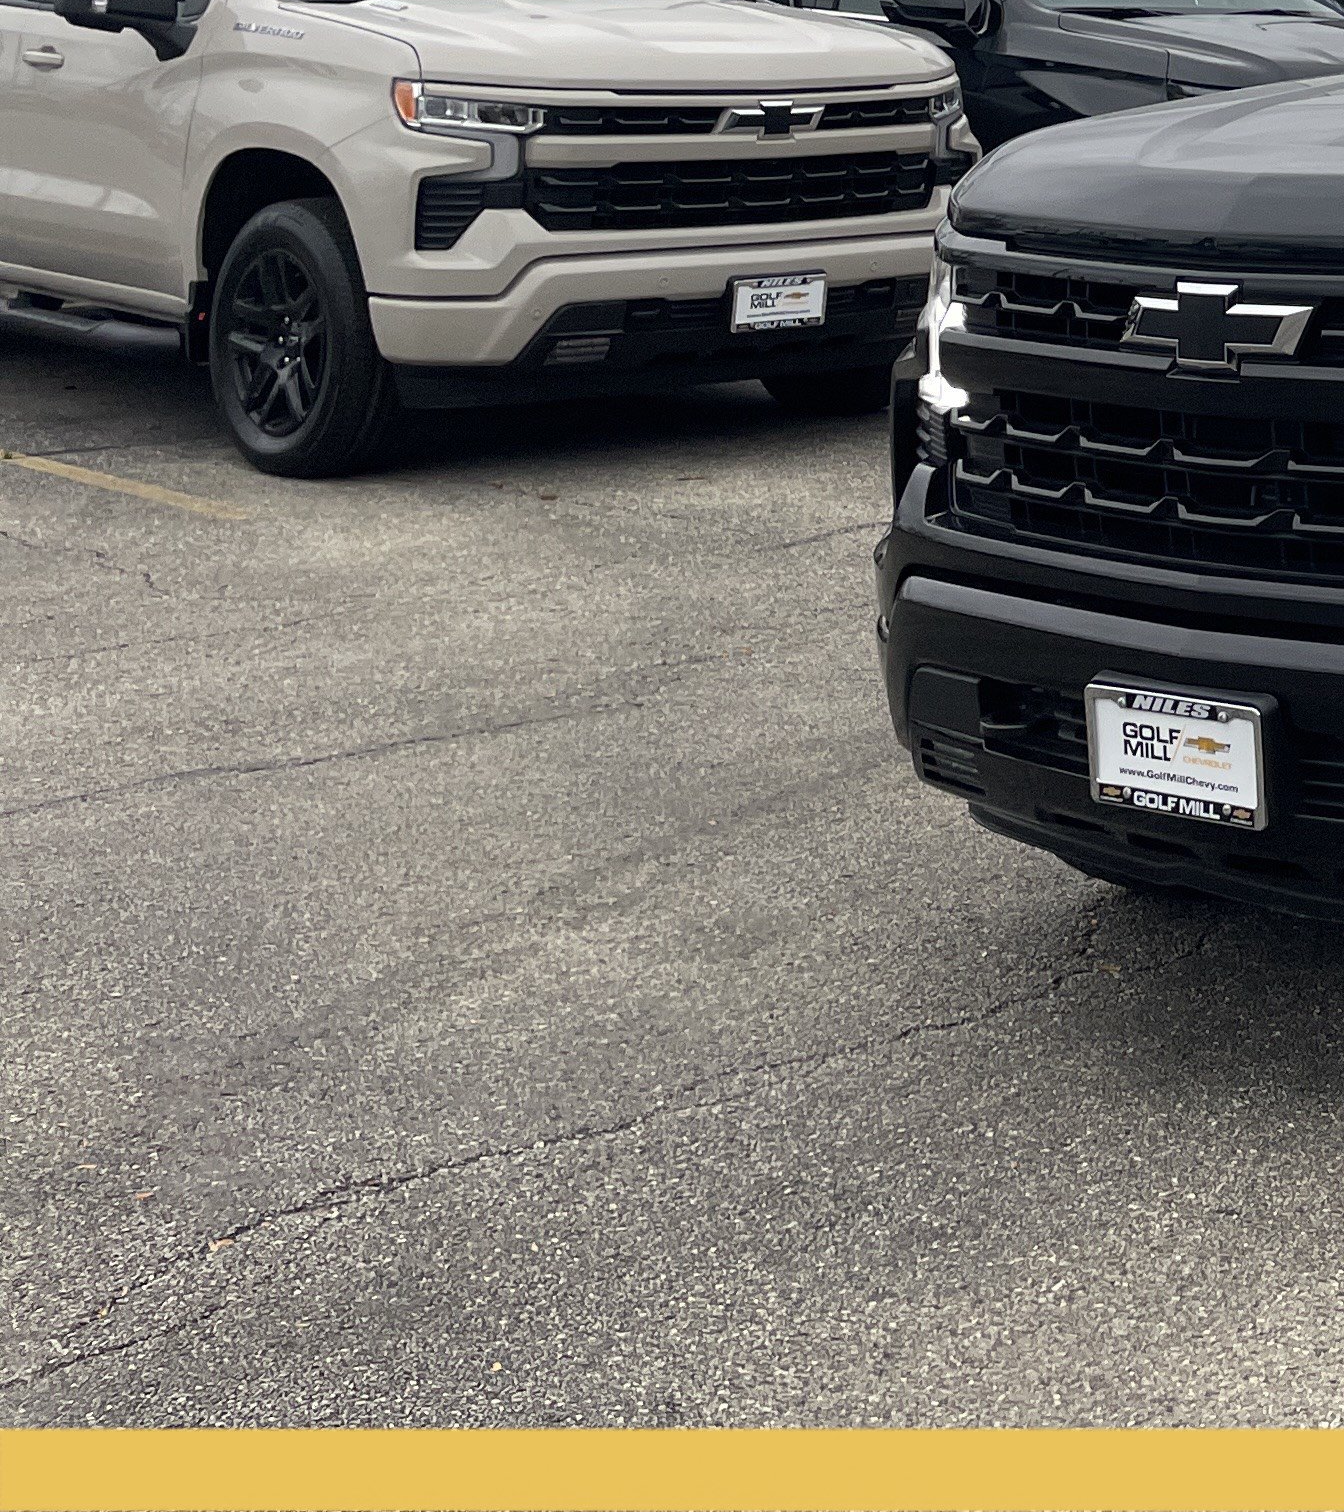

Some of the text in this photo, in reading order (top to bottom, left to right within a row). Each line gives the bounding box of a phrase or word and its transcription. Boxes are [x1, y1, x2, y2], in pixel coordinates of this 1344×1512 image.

[750, 291, 783, 302] GOLF
[1131, 694, 1211, 719] NILES
[1122, 721, 1181, 745] GOLF
[1123, 739, 1172, 762] MILL
[1118, 766, 1239, 794] www.GolfMillChevy.com
[1132, 790, 1221, 820] GOLF MILL
